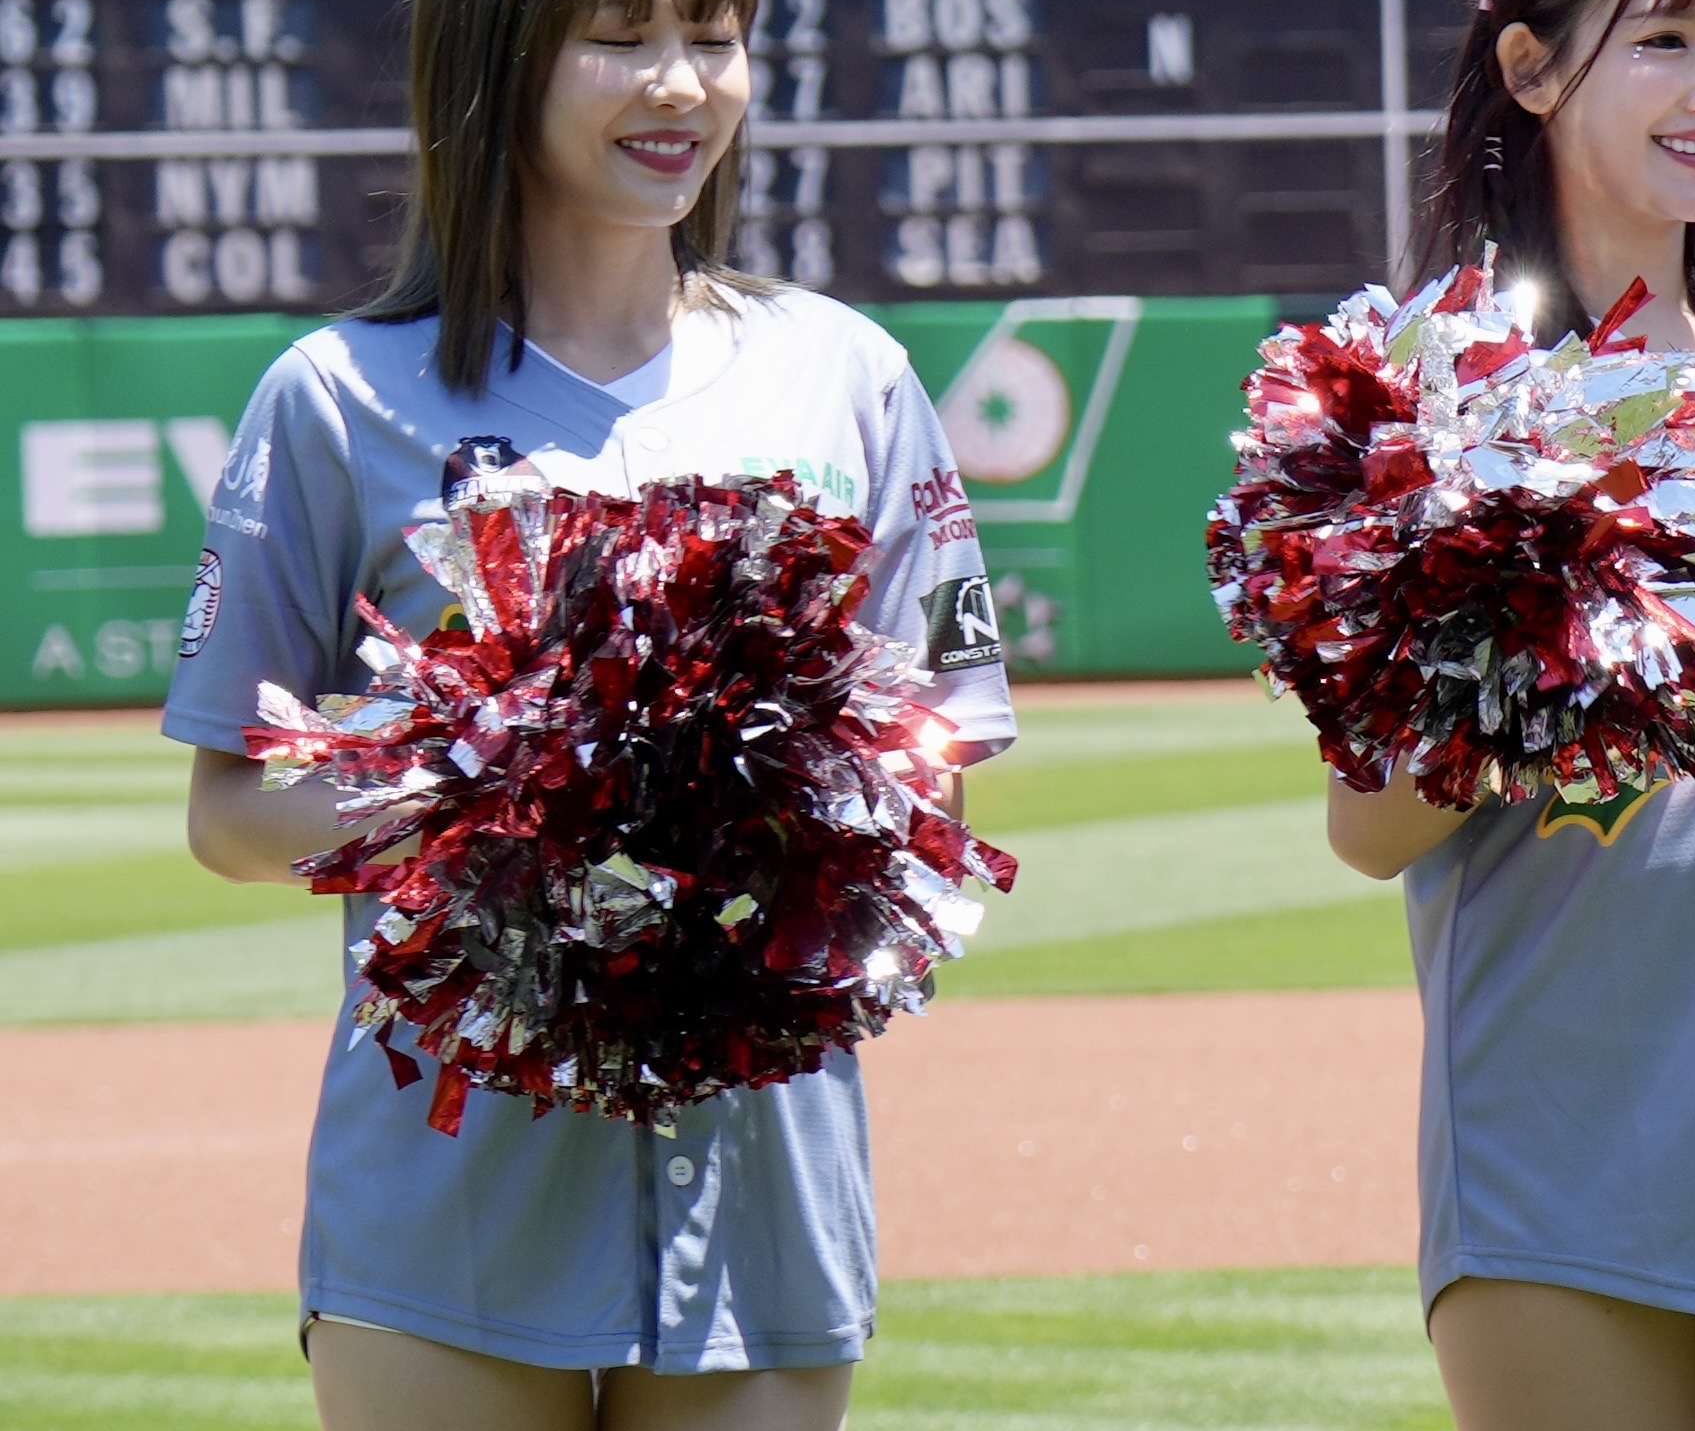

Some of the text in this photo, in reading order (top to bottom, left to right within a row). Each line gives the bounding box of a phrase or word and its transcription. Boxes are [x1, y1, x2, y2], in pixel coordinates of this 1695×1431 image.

[163, 63, 300, 130] MIL
[902, 52, 1031, 118] ARI
[156, 156, 320, 229] NYM
[163, 227, 310, 305] COL
[893, 213, 1042, 288] SEA
[21, 416, 234, 538] EV
